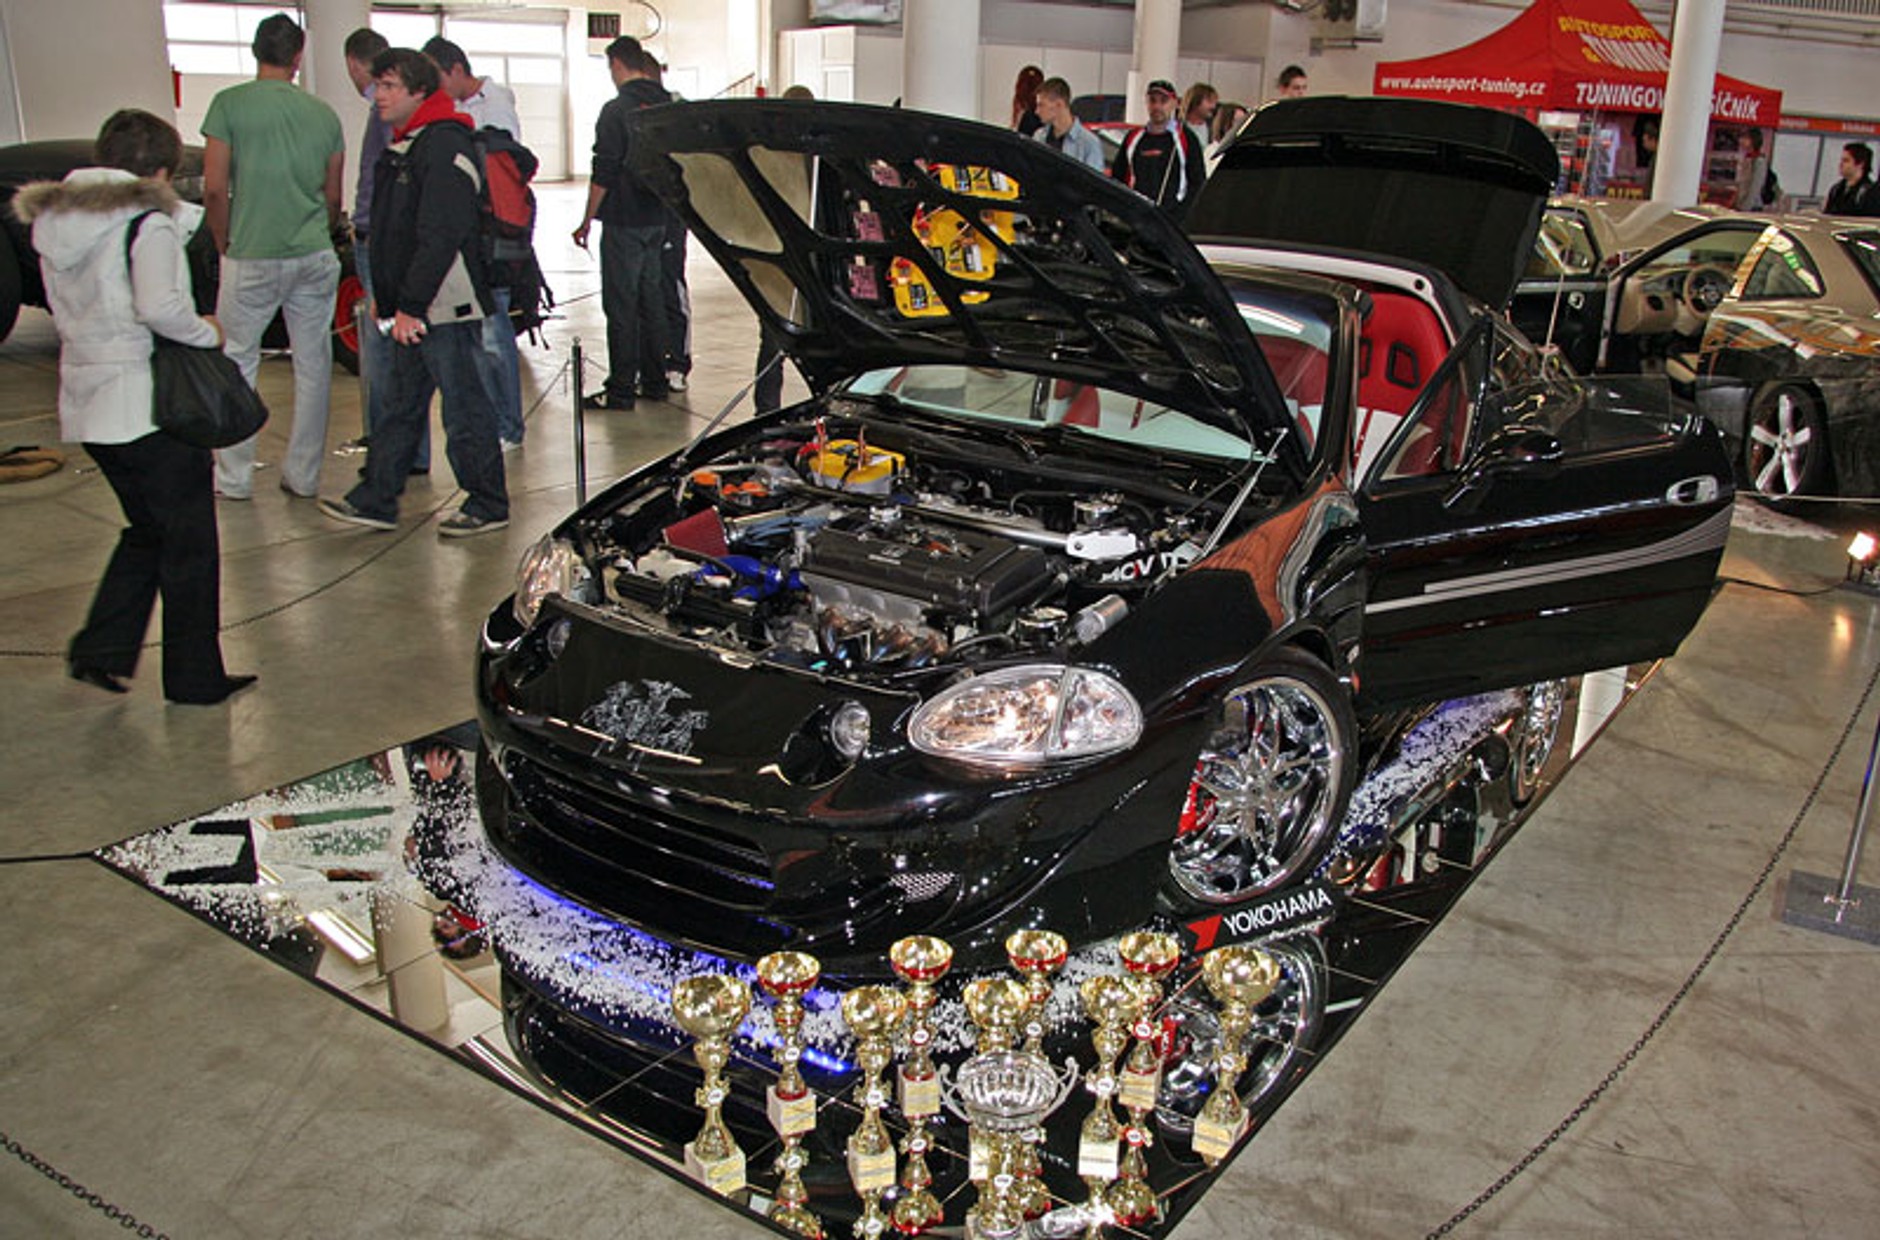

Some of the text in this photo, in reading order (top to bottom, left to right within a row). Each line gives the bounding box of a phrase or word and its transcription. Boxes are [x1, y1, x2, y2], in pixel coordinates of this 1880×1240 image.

[1558, 16, 1659, 43] AUTOSPORT
[1380, 76, 1546, 99] www.autosport-tuning.cz
[1224, 887, 1333, 936] YOKOHAMA
